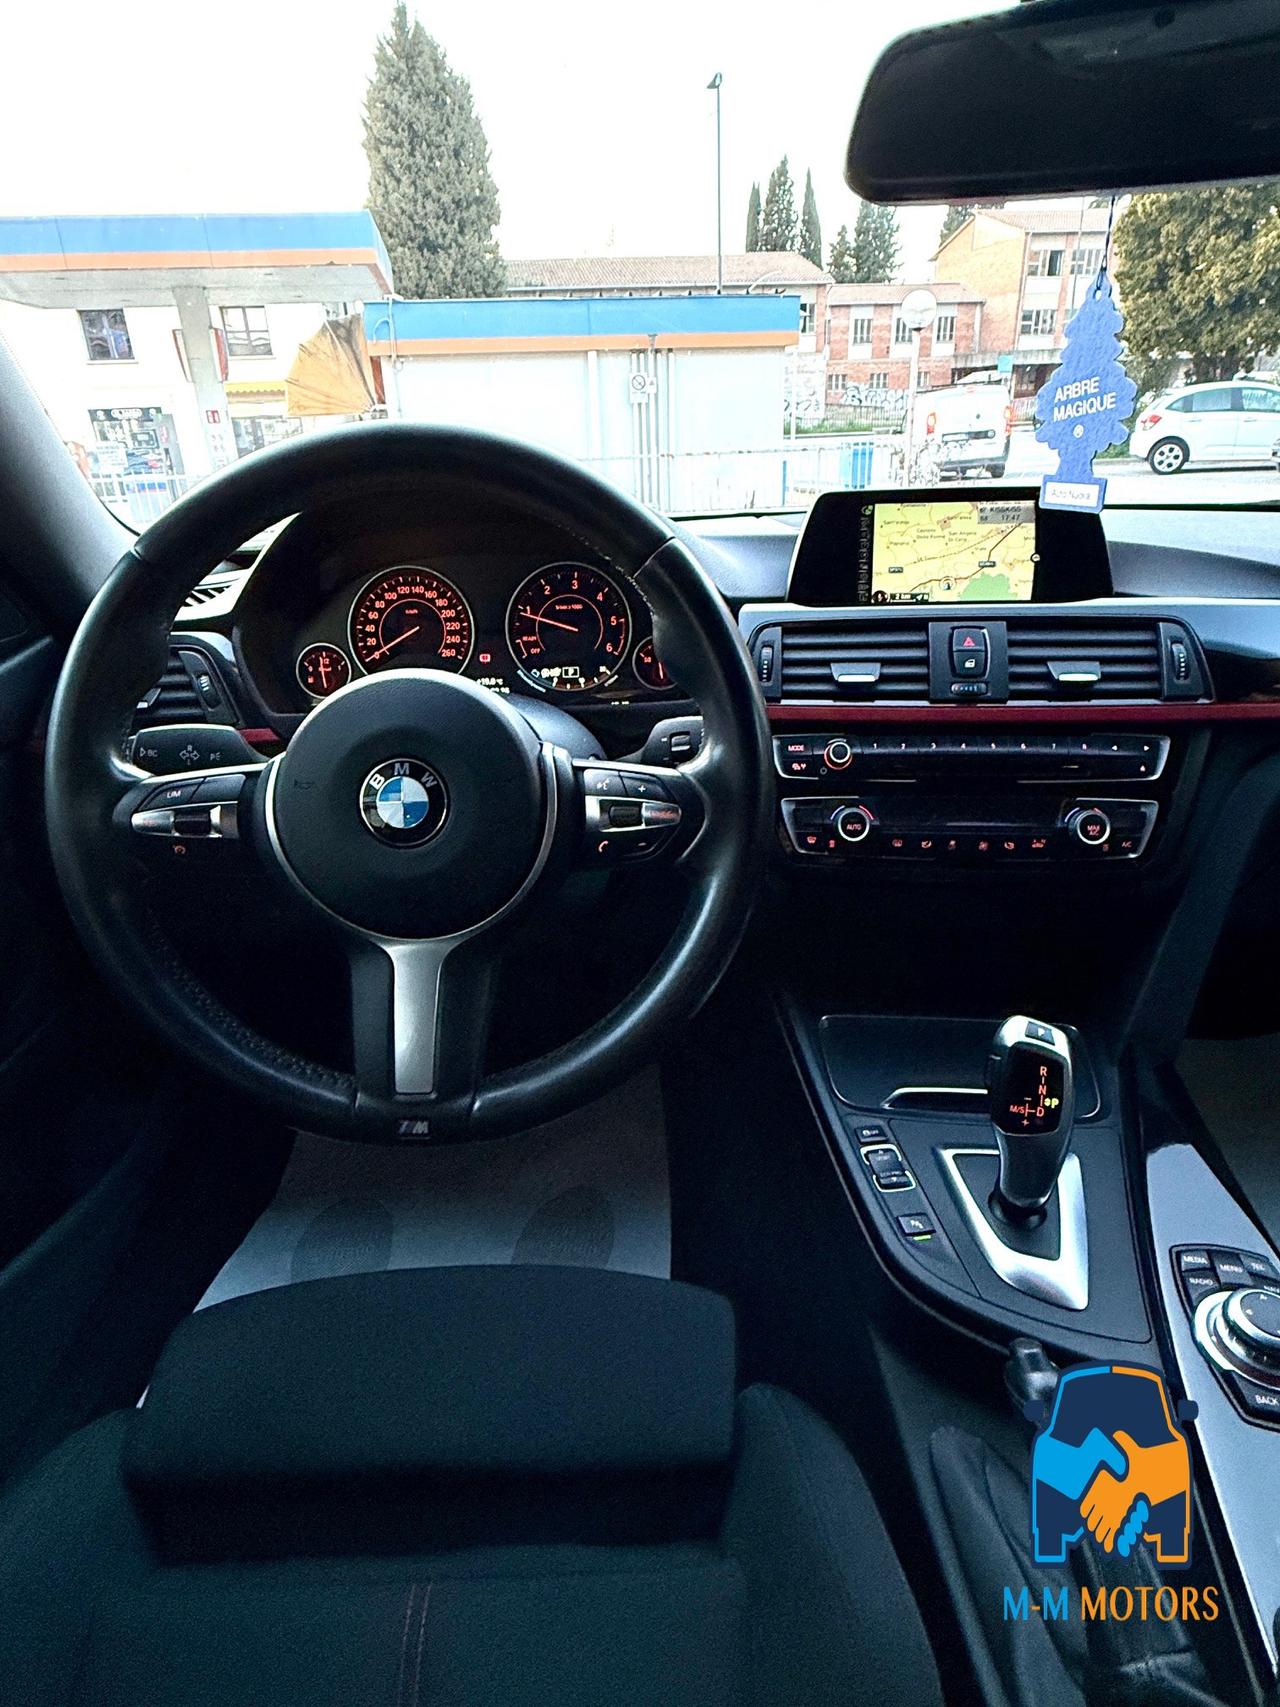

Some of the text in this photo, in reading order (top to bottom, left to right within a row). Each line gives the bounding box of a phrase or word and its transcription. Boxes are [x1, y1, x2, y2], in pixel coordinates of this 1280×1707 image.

[1055, 377, 1100, 403] ARBRE
[1053, 392, 1117, 422] MAGIQUE
[572, 580, 578, 590] 3
[397, 586, 410, 594] 120
[544, 585, 551, 595] 2
[384, 592, 397, 600] 100
[596, 592, 603, 601] 4
[375, 600, 385, 608] 80
[435, 599, 448, 607] 180
[441, 609, 456, 618] 200
[526, 605, 531, 615] 1
[368, 611, 379, 619] 60
[610, 616, 617, 626] 5
[446, 622, 460, 630] 220
[367, 637, 376, 645] 20
[446, 635, 461, 643] 240
[606, 642, 613, 652] 6
[441, 649, 456, 657] 260
[787, 744, 805, 752] MODE
[147, 749, 158, 757] BC
[368, 763, 438, 791] BMW
[166, 790, 181, 799] LIM
[846, 823, 862, 831] AUTO
[1040, 1065, 1048, 1077] R
[1038, 1084, 1047, 1096] N
[1009, 1105, 1025, 1114] M/S
[1036, 1107, 1045, 1117] D
[1183, 1255, 1208, 1265] MEDIA
[1219, 1263, 1243, 1273] MENU
[1189, 1277, 1214, 1286] RADIO
[1254, 1394, 1280, 1406] BACK
